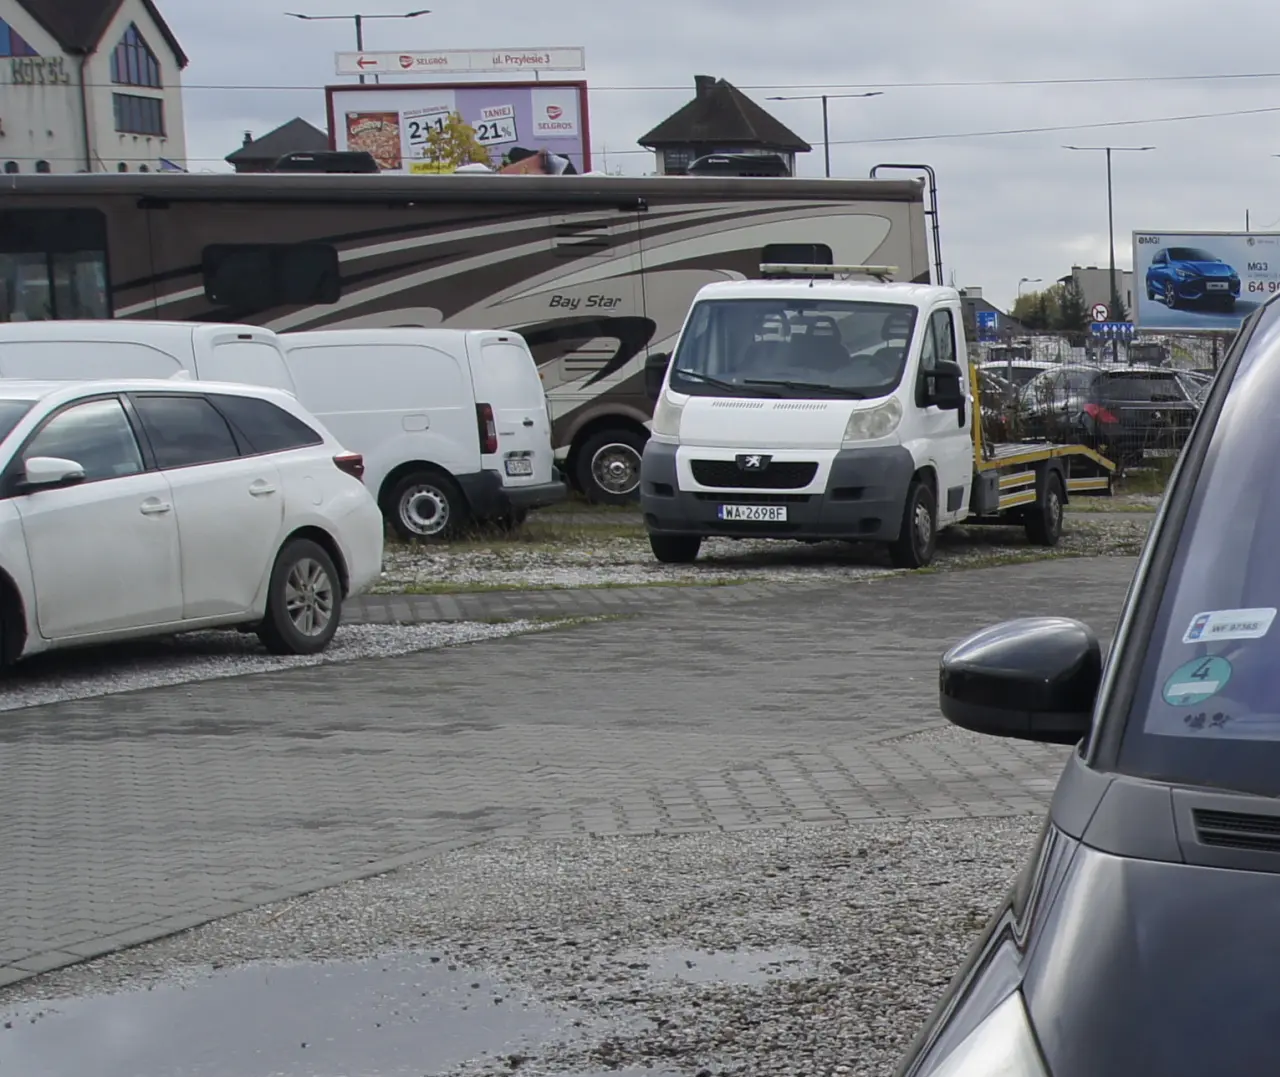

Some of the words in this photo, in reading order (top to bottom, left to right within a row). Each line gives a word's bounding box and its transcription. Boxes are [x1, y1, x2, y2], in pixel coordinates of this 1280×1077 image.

[416, 58, 448, 66] SELGROS
[492, 56, 503, 65] ul.
[483, 106, 512, 119] TANIEJ
[537, 122, 573, 131] SELGROS
[1247, 261, 1268, 271] MG3
[1248, 281, 1264, 293] 64
[549, 295, 581, 311] Bay
[585, 294, 622, 308] Star
[724, 506, 742, 519] WA
[745, 507, 785, 520] 2698F
[1190, 657, 1215, 680] 4
